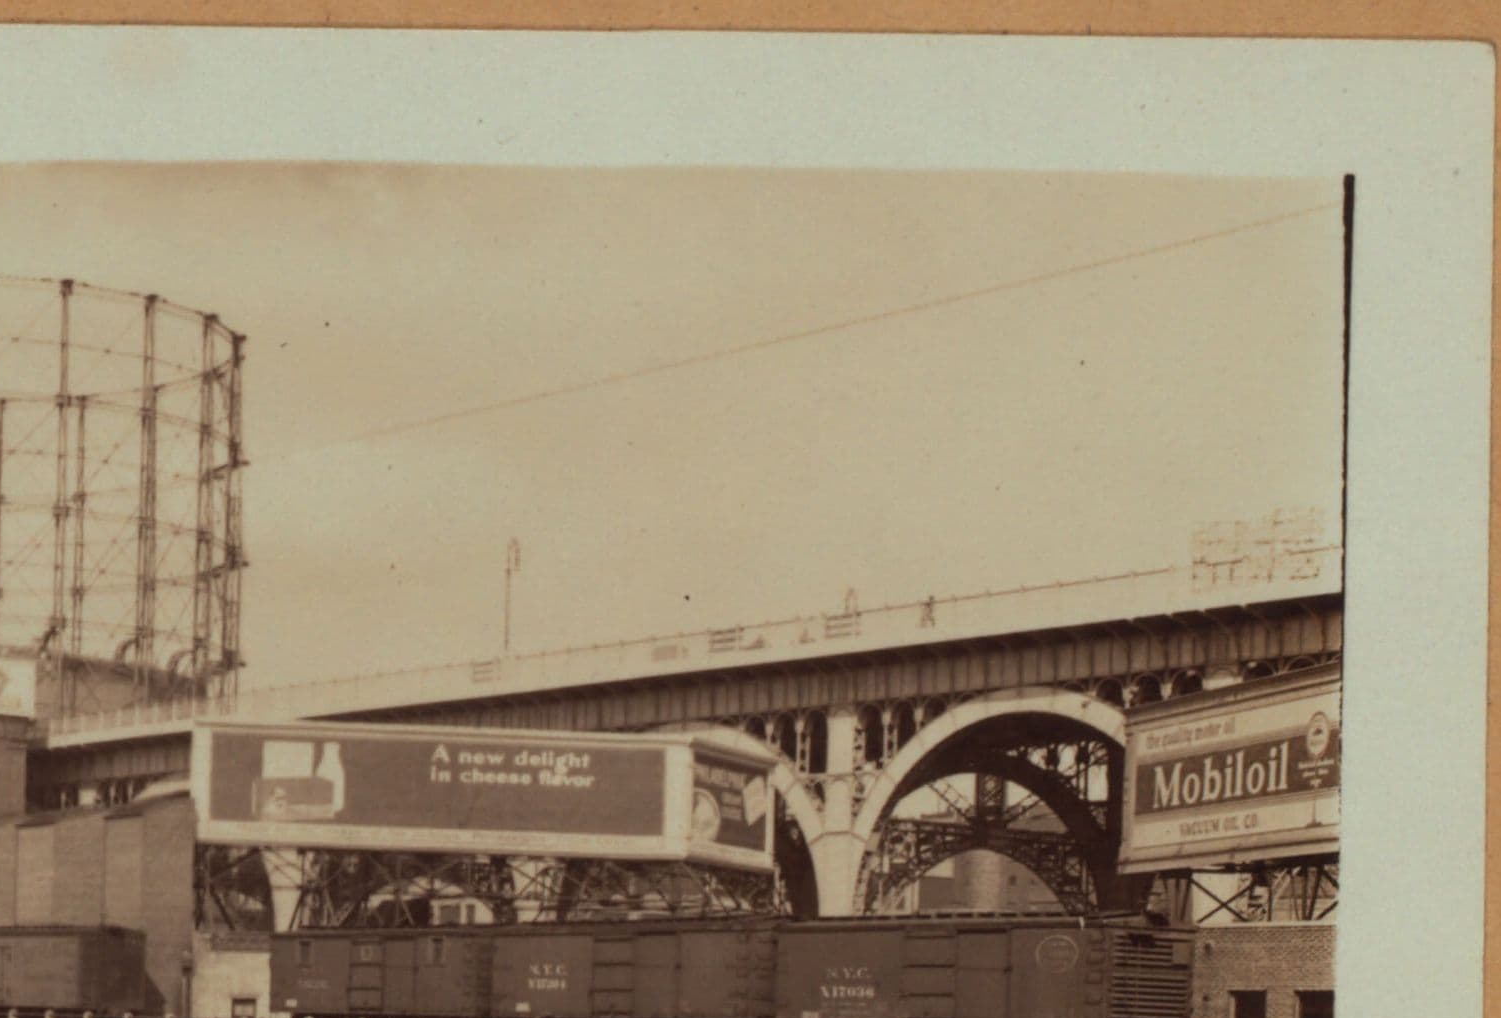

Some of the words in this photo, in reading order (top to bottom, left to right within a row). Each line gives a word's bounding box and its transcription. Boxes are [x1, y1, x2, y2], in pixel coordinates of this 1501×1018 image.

[431, 744, 451, 764] A
[458, 750, 504, 765] new
[514, 749, 591, 773] delight
[459, 767, 533, 786] cheese
[538, 768, 596, 788] flavor
[1152, 740, 1290, 810] Mobiloil
